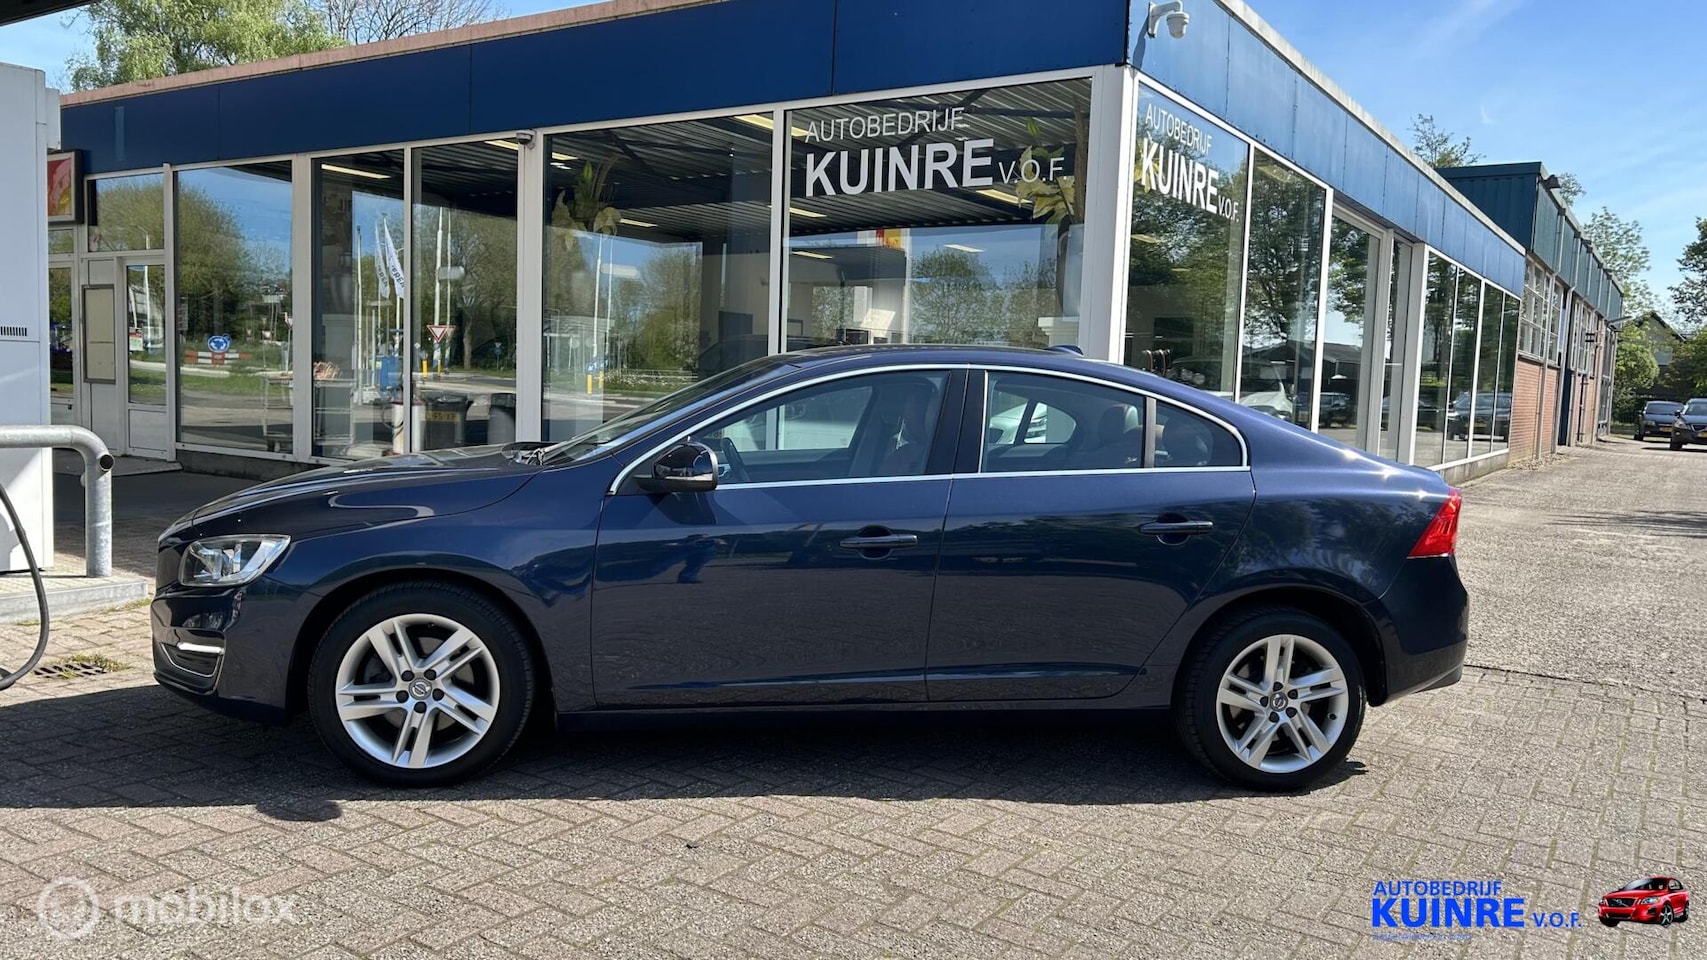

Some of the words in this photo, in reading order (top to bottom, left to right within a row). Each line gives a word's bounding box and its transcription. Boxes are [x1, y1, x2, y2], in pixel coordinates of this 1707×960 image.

[805, 106, 965, 143] AUTOBEDRIJF
[1145, 103, 1213, 154] AUTOBEDRIJF
[805, 138, 994, 197] KUINRE
[1141, 137, 1219, 214] KUINRE
